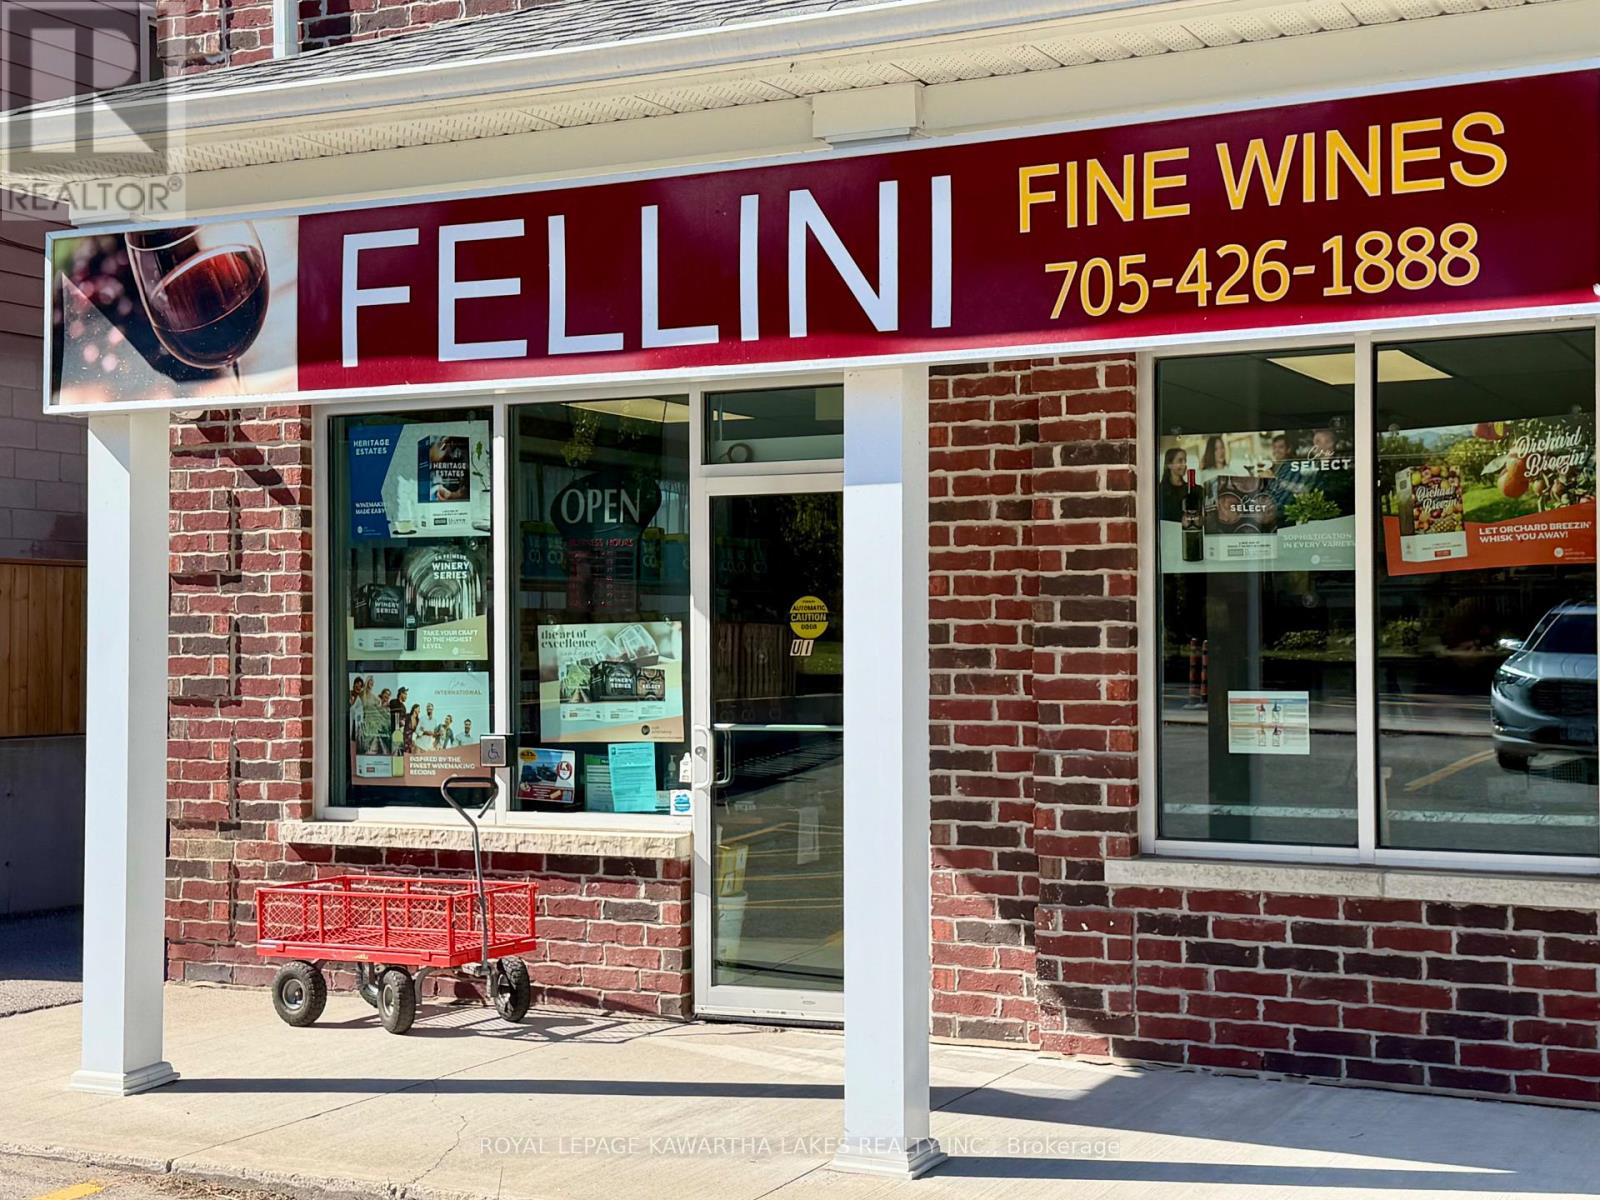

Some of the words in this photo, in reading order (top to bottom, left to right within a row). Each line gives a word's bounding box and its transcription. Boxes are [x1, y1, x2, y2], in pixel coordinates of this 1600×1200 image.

[1018, 147, 1191, 233] FINE
[1215, 111, 1508, 211] WINES
[341, 174, 952, 368] FELLINI
[1044, 222, 1481, 320] 705-426-1888
[353, 439, 390, 447] HERITAGE
[1515, 425, 1583, 459] Orchard
[355, 447, 387, 456] ESTATES
[433, 462, 467, 470] HERITAGE
[1290, 459, 1351, 473] SELECT
[560, 488, 641, 524] OPEN
[1230, 504, 1267, 513] SELECT
[1479, 527, 1498, 535] LET
[1499, 523, 1548, 534] ORCHARD
[1549, 521, 1591, 531] BREEZIN'
[1479, 534, 1513, 544] WHISK
[1515, 533, 1536, 542] YOU
[1537, 531, 1569, 540] AWAY!
[1294, 541, 1320, 549] EVERY
[431, 561, 470, 571] WINERY
[433, 571, 468, 580] SERIES
[791, 613, 827, 621] CAUTION
[541, 630, 558, 639] the
[559, 630, 575, 639] art
[576, 629, 587, 638] of
[541, 639, 597, 648] excellence
